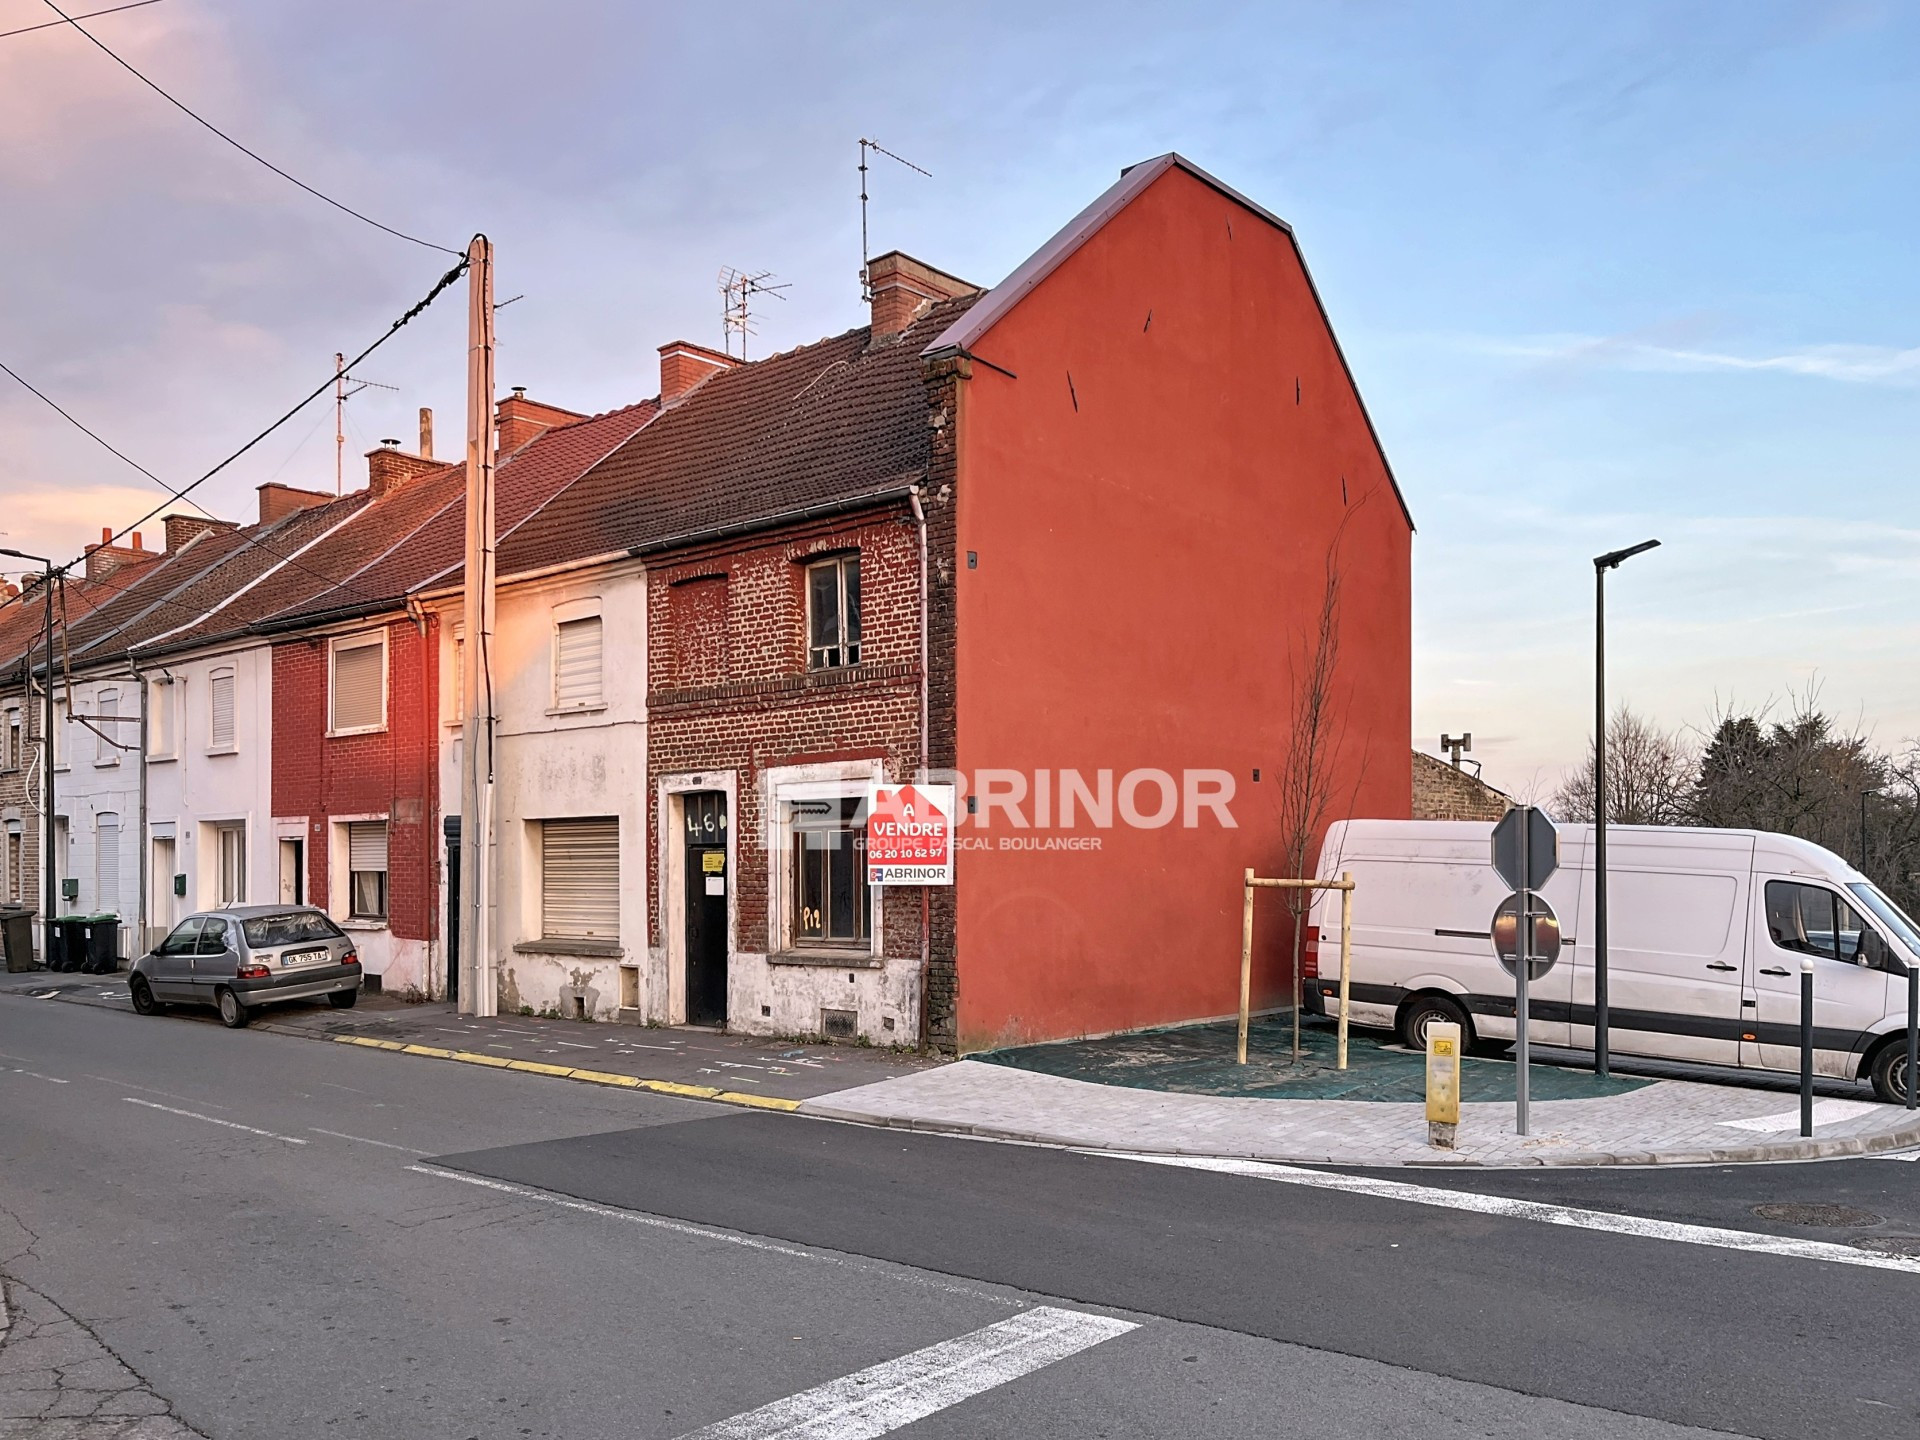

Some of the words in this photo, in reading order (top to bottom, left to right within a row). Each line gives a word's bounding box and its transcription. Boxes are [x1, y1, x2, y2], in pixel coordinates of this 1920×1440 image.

[903, 803, 915, 817] A
[873, 822, 944, 837] VENDRE
[869, 849, 882, 859] 06
[884, 849, 898, 859] 20
[900, 849, 913, 859] 10
[914, 848, 928, 858] 62
[929, 848, 942, 857] 97
[884, 868, 946, 879] ABRINOR
